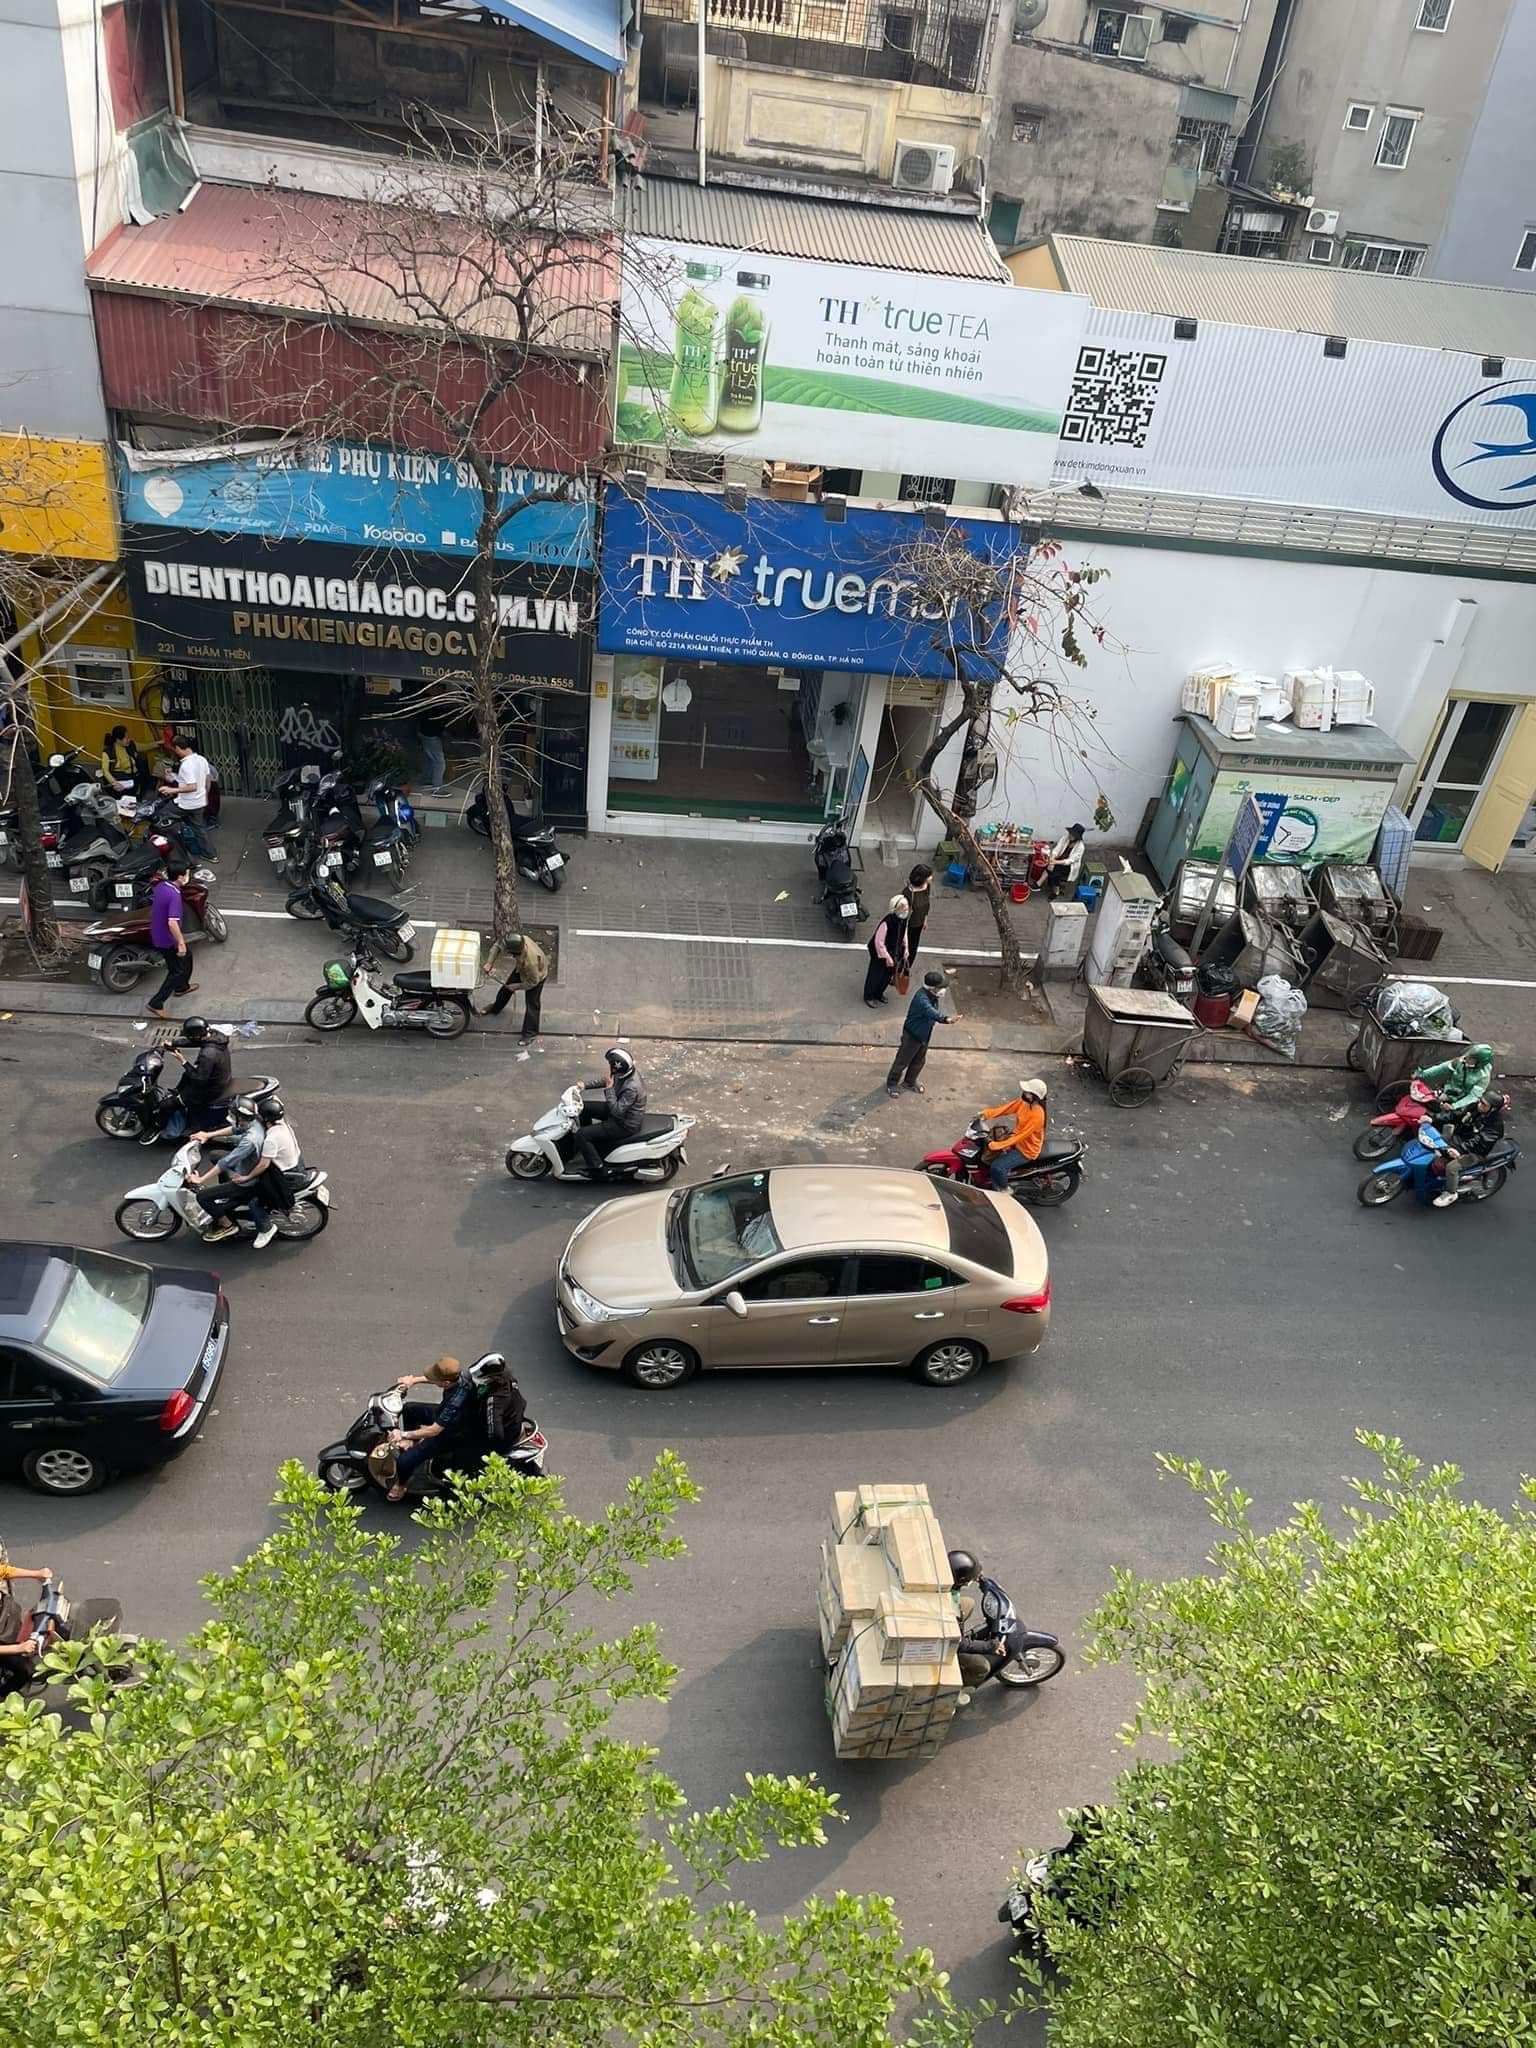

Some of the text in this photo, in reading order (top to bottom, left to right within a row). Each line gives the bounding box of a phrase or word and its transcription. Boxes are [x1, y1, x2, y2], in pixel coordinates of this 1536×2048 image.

[819, 297, 861, 325] TH
[825, 331, 868, 350] Thanh
[732, 347, 749, 359] TH
[730, 358, 760, 375] true
[907, 359, 941, 377] thiên
[945, 365, 983, 382] nhiên
[729, 372, 757, 390] TEA
[338, 448, 382, 484] PHỤ
[388, 453, 440, 489] KIỆN
[456, 461, 528, 495] SMRT
[630, 553, 709, 601] TH
[144, 560, 579, 633] DIENTHOAIGIAGOC.CM.VN
[157, 642, 175, 653] 221
[626, 627, 648, 637] CÔNG
[650, 629, 659, 637] TY
[763, 640, 773, 648] TH
[668, 641, 686, 650] 221A
